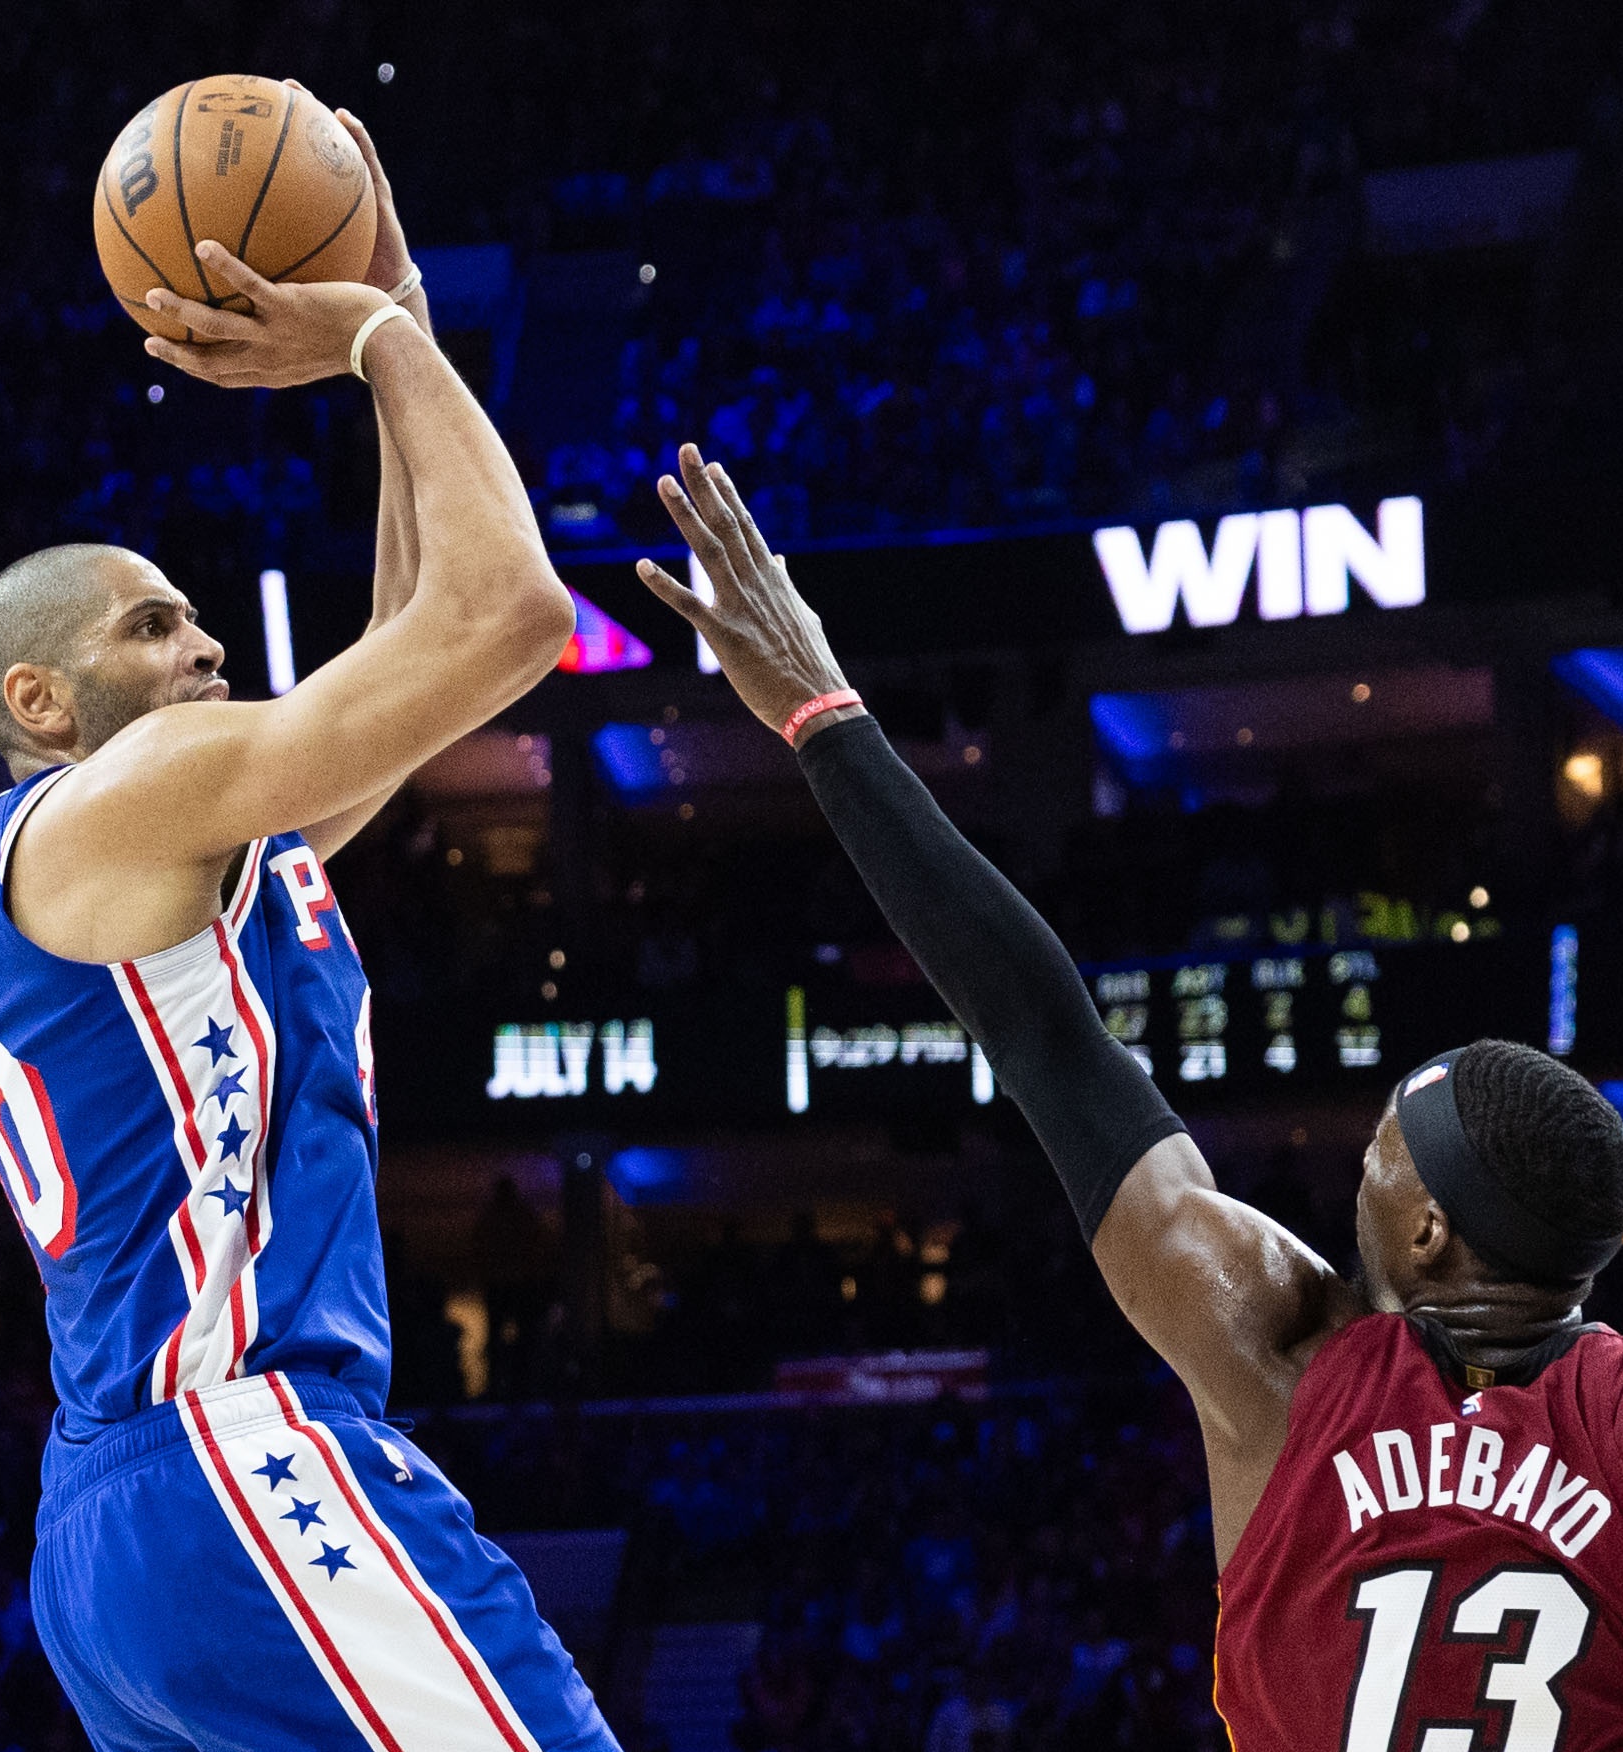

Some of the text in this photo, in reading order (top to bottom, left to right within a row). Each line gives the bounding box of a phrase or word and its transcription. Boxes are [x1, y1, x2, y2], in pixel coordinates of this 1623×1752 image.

[1092, 495, 1425, 635] WIN
[486, 1018, 658, 1099] JULY 14
[1331, 1421, 1612, 1560] ADEBAYO
